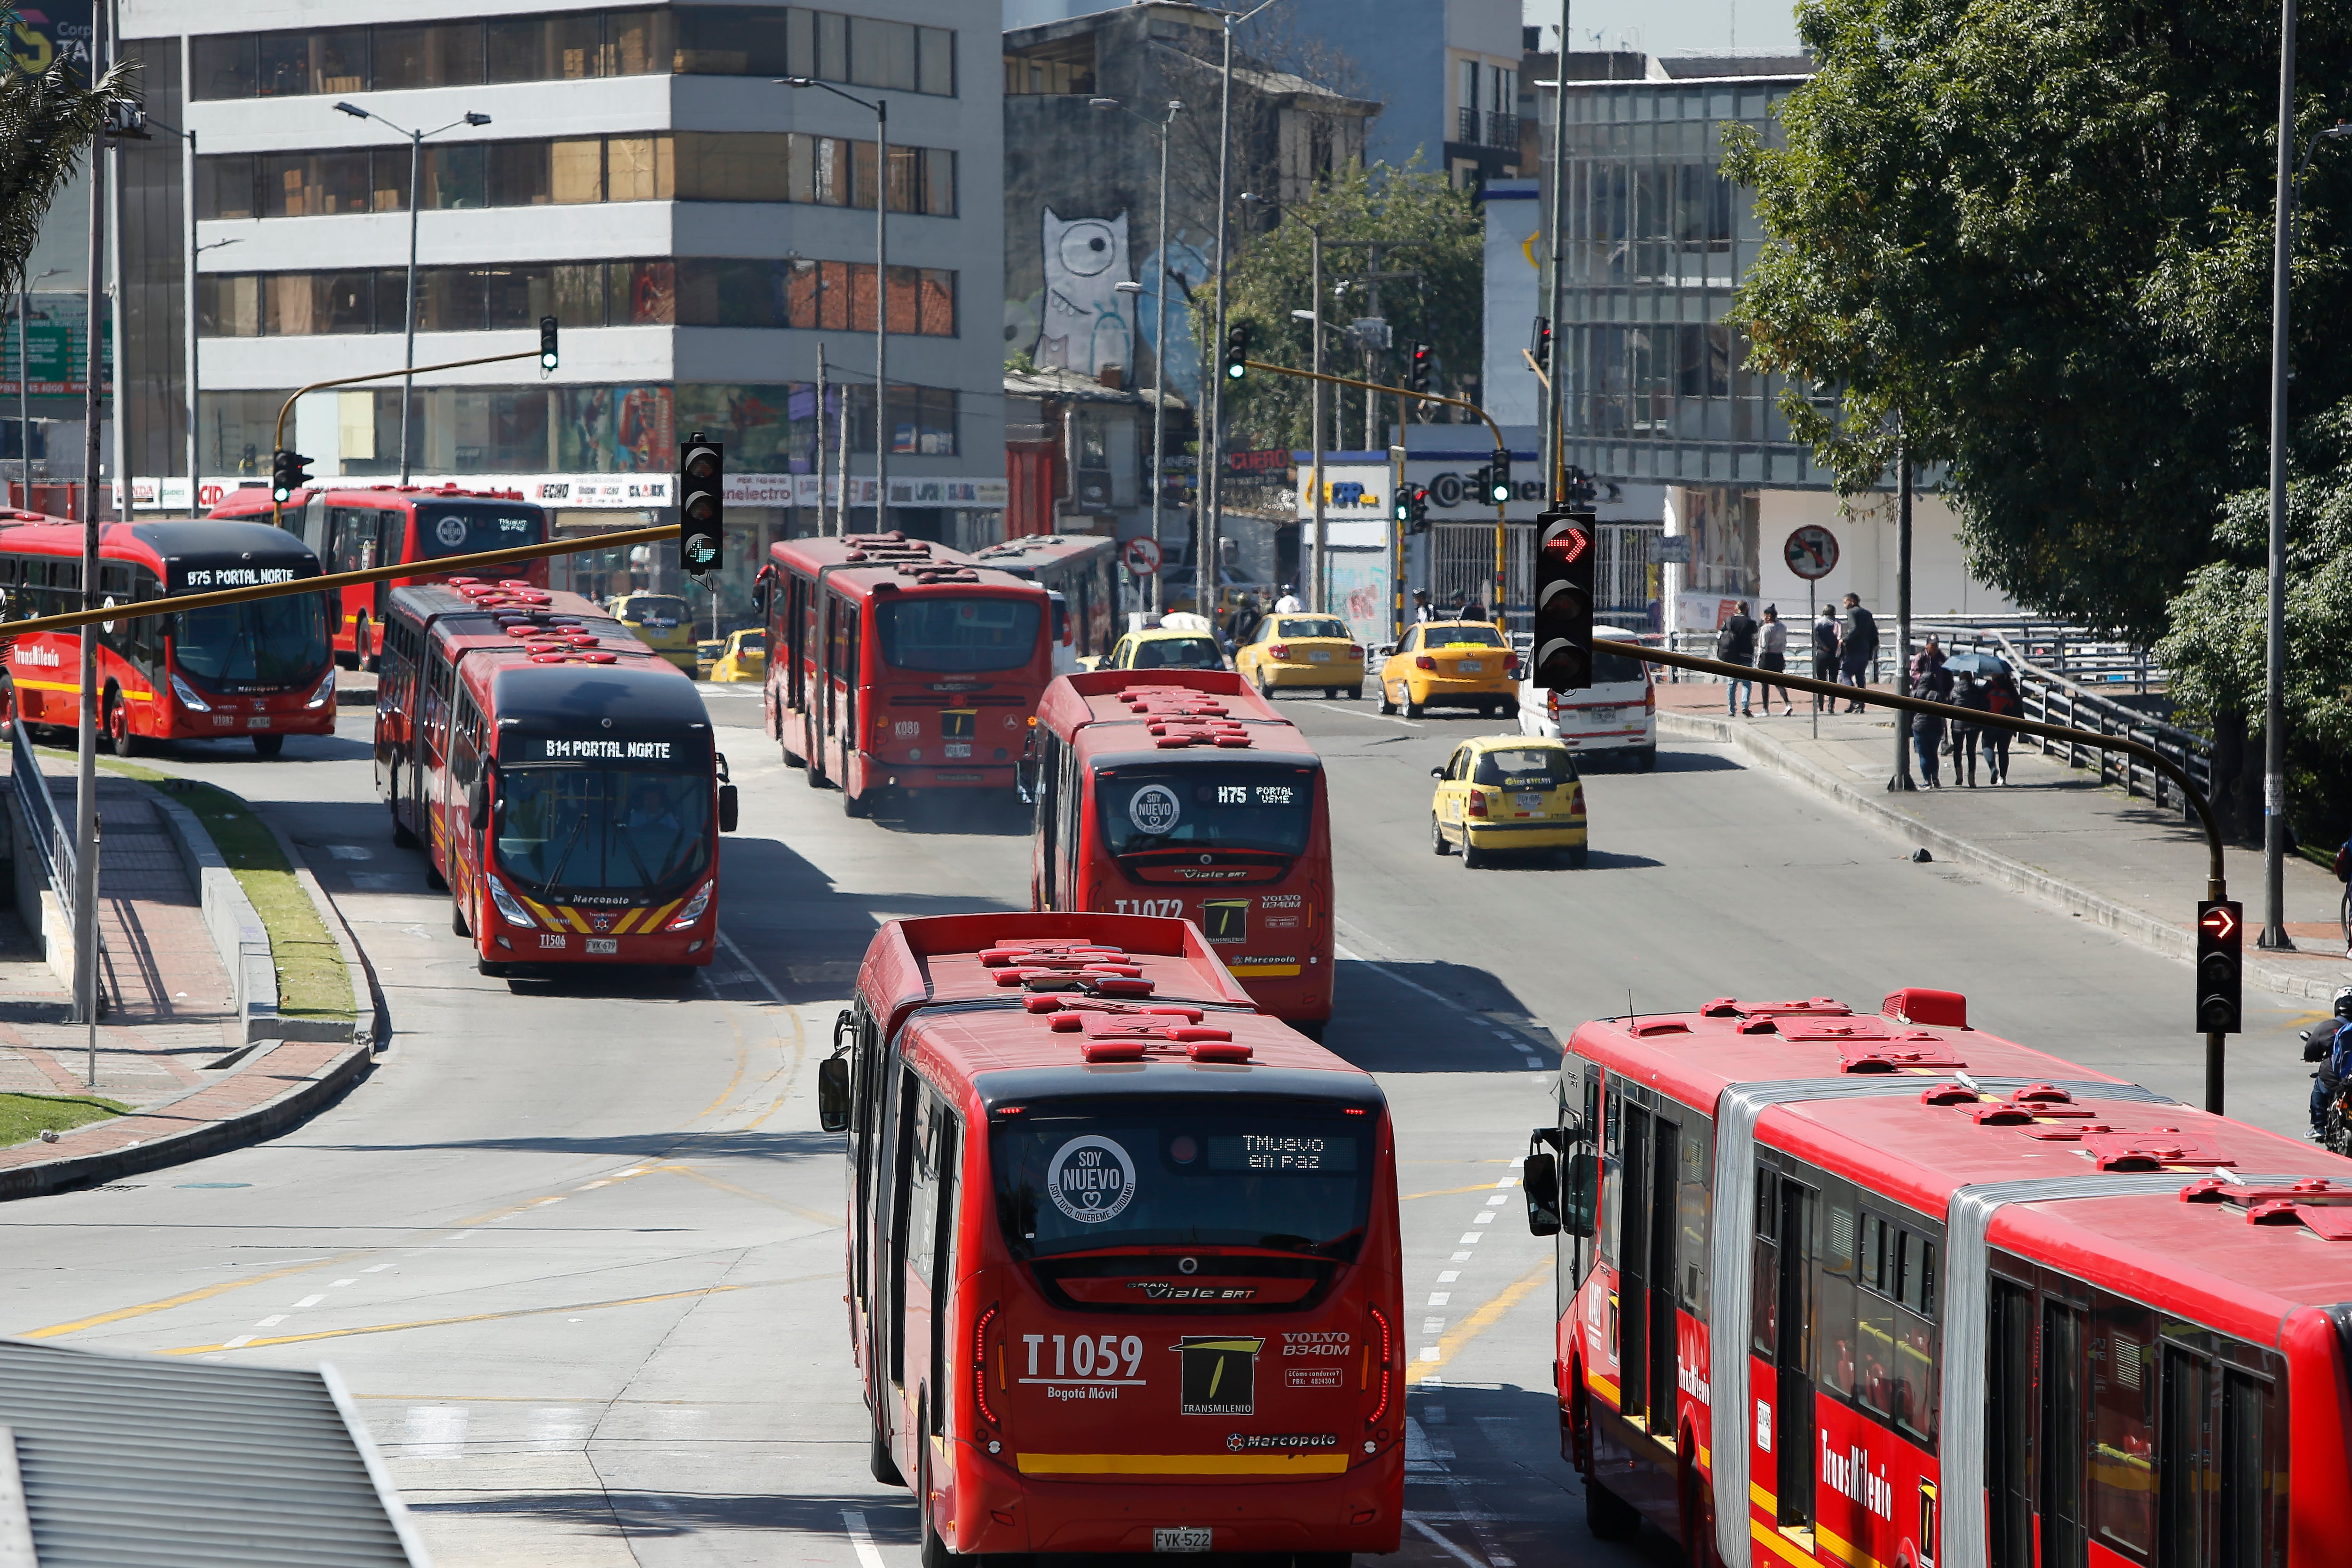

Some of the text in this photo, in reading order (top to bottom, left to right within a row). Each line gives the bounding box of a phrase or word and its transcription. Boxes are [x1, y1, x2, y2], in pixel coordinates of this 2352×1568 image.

[1231, 449, 1287, 470] CUERO
[215, 569, 259, 585] PORTAL
[260, 568, 294, 584] NORTE
[14, 644, 60, 668] TransMilenio
[546, 740, 671, 759] B14 PORTAL NORTE
[1147, 793, 1161, 803] SOY
[1218, 786, 1293, 804] H75 PORTAL
[1262, 795, 1290, 804] USME
[1138, 804, 1171, 816] NUEVO
[1184, 870, 1224, 879] Viale
[572, 895, 629, 905] Marcopolo
[540, 934, 566, 947] T1506
[1244, 956, 1295, 964] Marcopolo
[1242, 1135, 1324, 1151] TMuevo
[1079, 1152, 1102, 1167] SOY
[1249, 1154, 1273, 1168] en
[1063, 1169, 1120, 1191] NUEVO
[1145, 1288, 1215, 1298] Viale
[1281, 1332, 1350, 1343] VOLVO
[1023, 1334, 1144, 1377] T1059
[1282, 1345, 1351, 1356] B340M
[1677, 1354, 1710, 1407] TransMilenio
[1048, 1386, 1118, 1401] Bogotá Móvil
[1184, 1404, 1252, 1413] TRANSMILENIO
[1248, 1434, 1337, 1447] Marcopolo
[1821, 1428, 1892, 1522] TransMilenio
[1155, 1533, 1210, 1547] FVK-522
